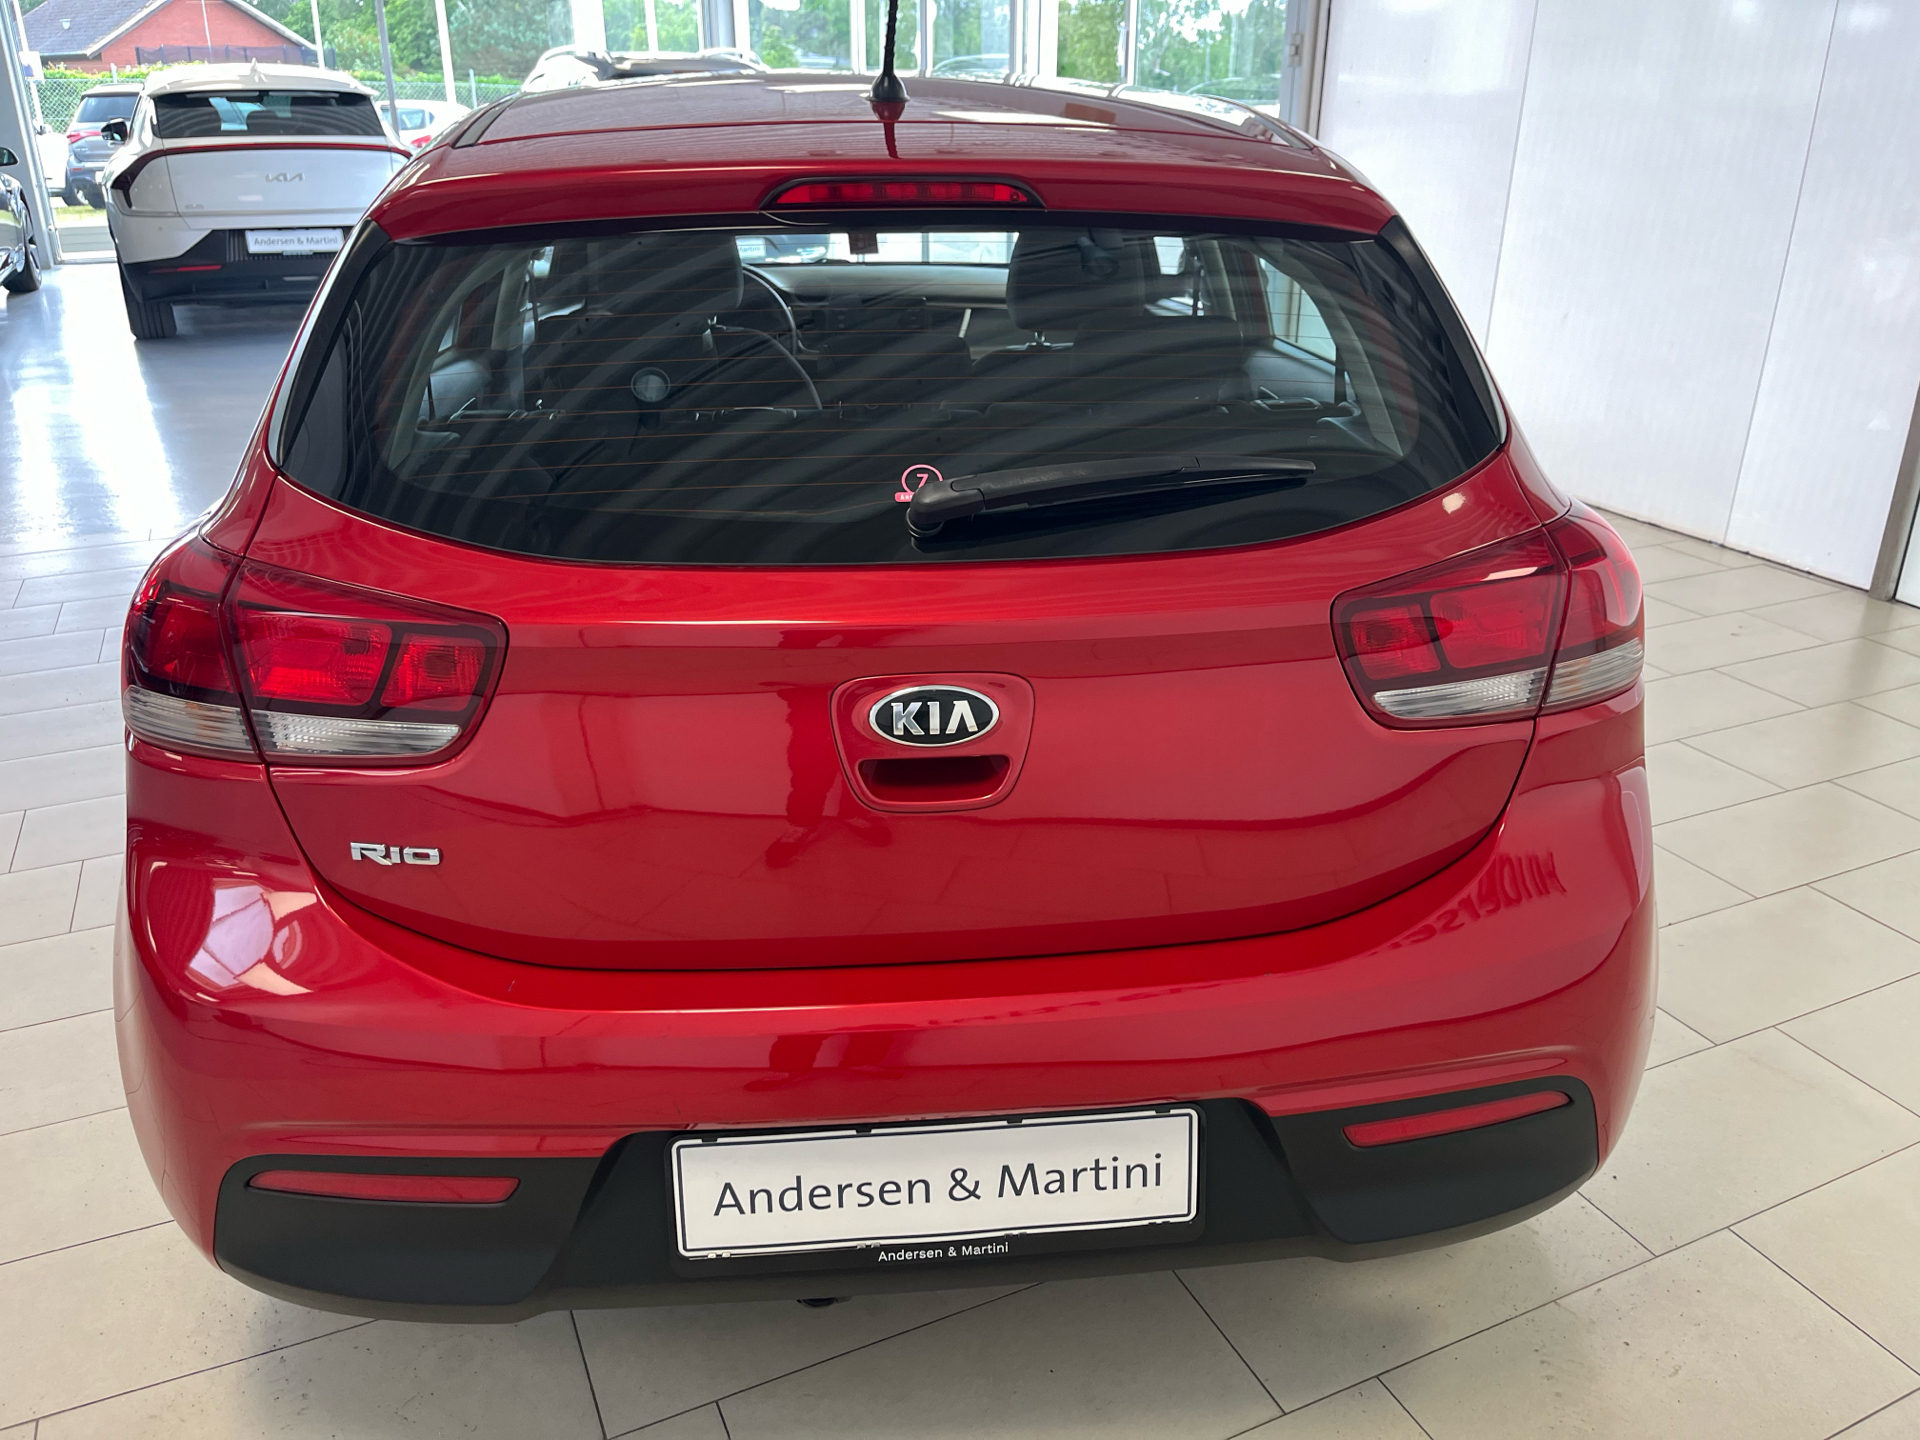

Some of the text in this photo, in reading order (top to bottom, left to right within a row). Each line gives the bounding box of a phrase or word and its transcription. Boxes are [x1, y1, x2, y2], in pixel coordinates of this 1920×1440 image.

[254, 235, 338, 246] Andersen & Martini
[916, 473, 929, 489] 7
[891, 700, 978, 735] KIA
[713, 1153, 1162, 1216] Andersen & Martini
[878, 1242, 1009, 1262] Andersen & Martini
